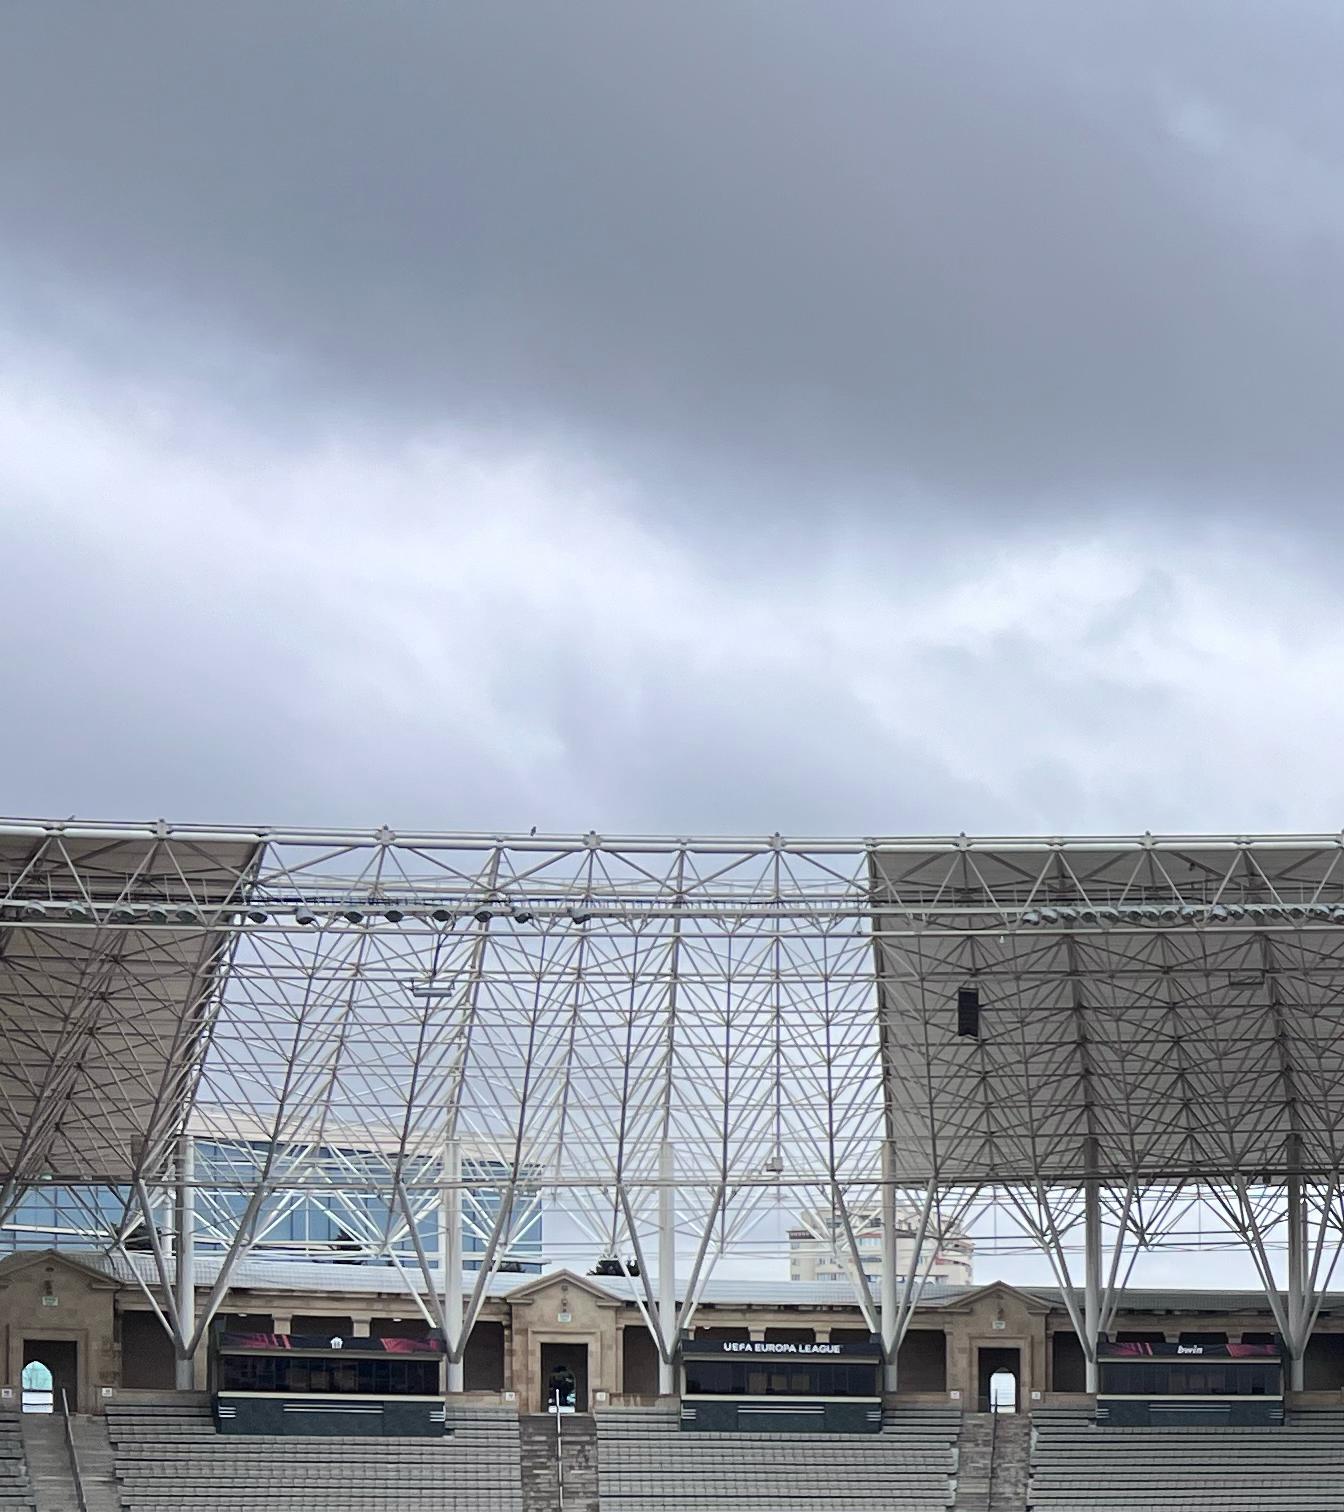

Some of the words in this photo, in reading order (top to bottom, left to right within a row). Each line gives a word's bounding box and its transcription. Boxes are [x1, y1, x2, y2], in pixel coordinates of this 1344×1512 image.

[723, 1342, 753, 1352] UEFA
[754, 1342, 797, 1353] EUROPA
[798, 1344, 841, 1354] LEAGUE
